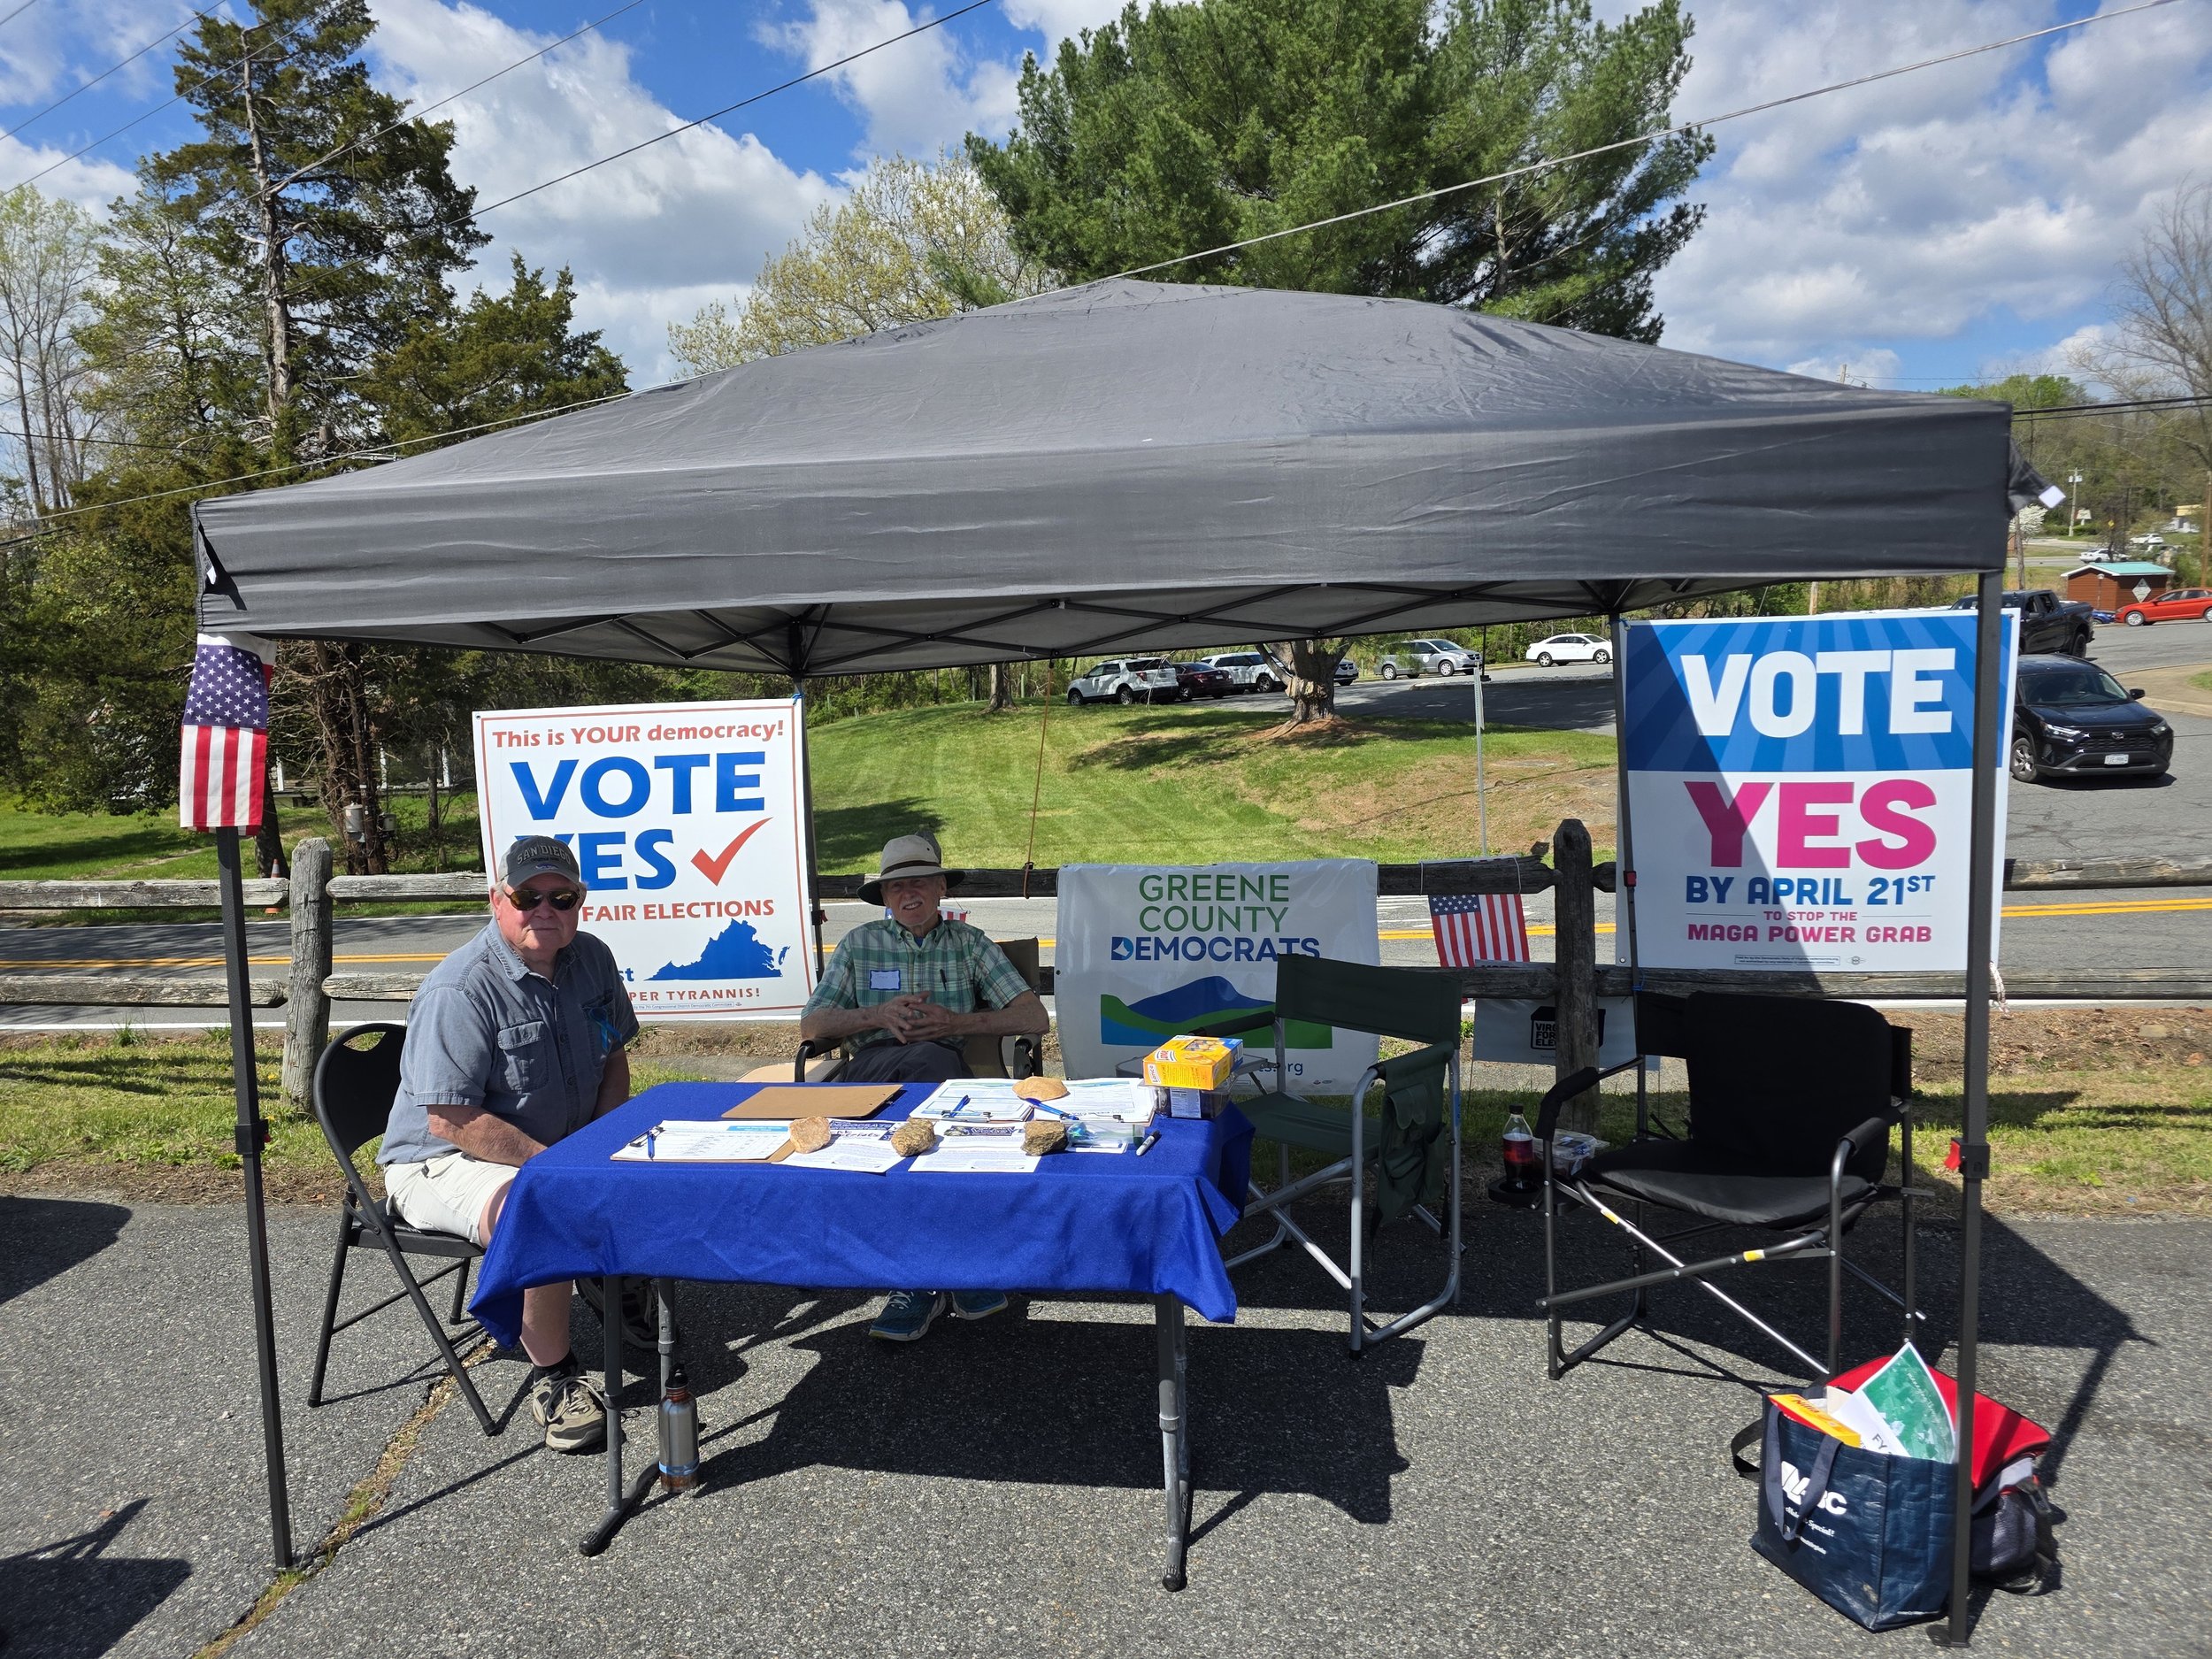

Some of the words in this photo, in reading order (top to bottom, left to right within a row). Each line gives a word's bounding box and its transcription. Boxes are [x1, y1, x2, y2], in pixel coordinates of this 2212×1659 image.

[1681, 648, 1955, 737] VOTE
[493, 731, 540, 748] This
[548, 728, 565, 746] is
[571, 725, 641, 744] YOUR
[647, 720, 784, 741] democracy!
[509, 751, 765, 820] VOTE
[1683, 780, 1937, 869] YES
[517, 847, 538, 864] SAN
[541, 845, 572, 864] DIEGO
[1140, 874, 1290, 902] GREENE
[1686, 876, 1734, 903] BY
[1747, 877, 1853, 905] APRIL
[1867, 875, 1936, 905] 21ST
[582, 904, 636, 922] FAIR
[644, 900, 774, 920] ELECTIONS
[1139, 905, 1288, 933] COUNTY
[1764, 911, 1782, 921] TO
[1787, 911, 1824, 921] STOP
[1830, 911, 1858, 921] THE
[1687, 925, 1758, 942] MAGA
[1769, 926, 1856, 943] POWER
[1866, 925, 1932, 943] GRAB
[1111, 936, 1320, 962] DEMOCRATS
[628, 992, 660, 1002] PER
[667, 987, 761, 1001] TYRANNIS!
[1871, 1433, 1887, 1450] FY
